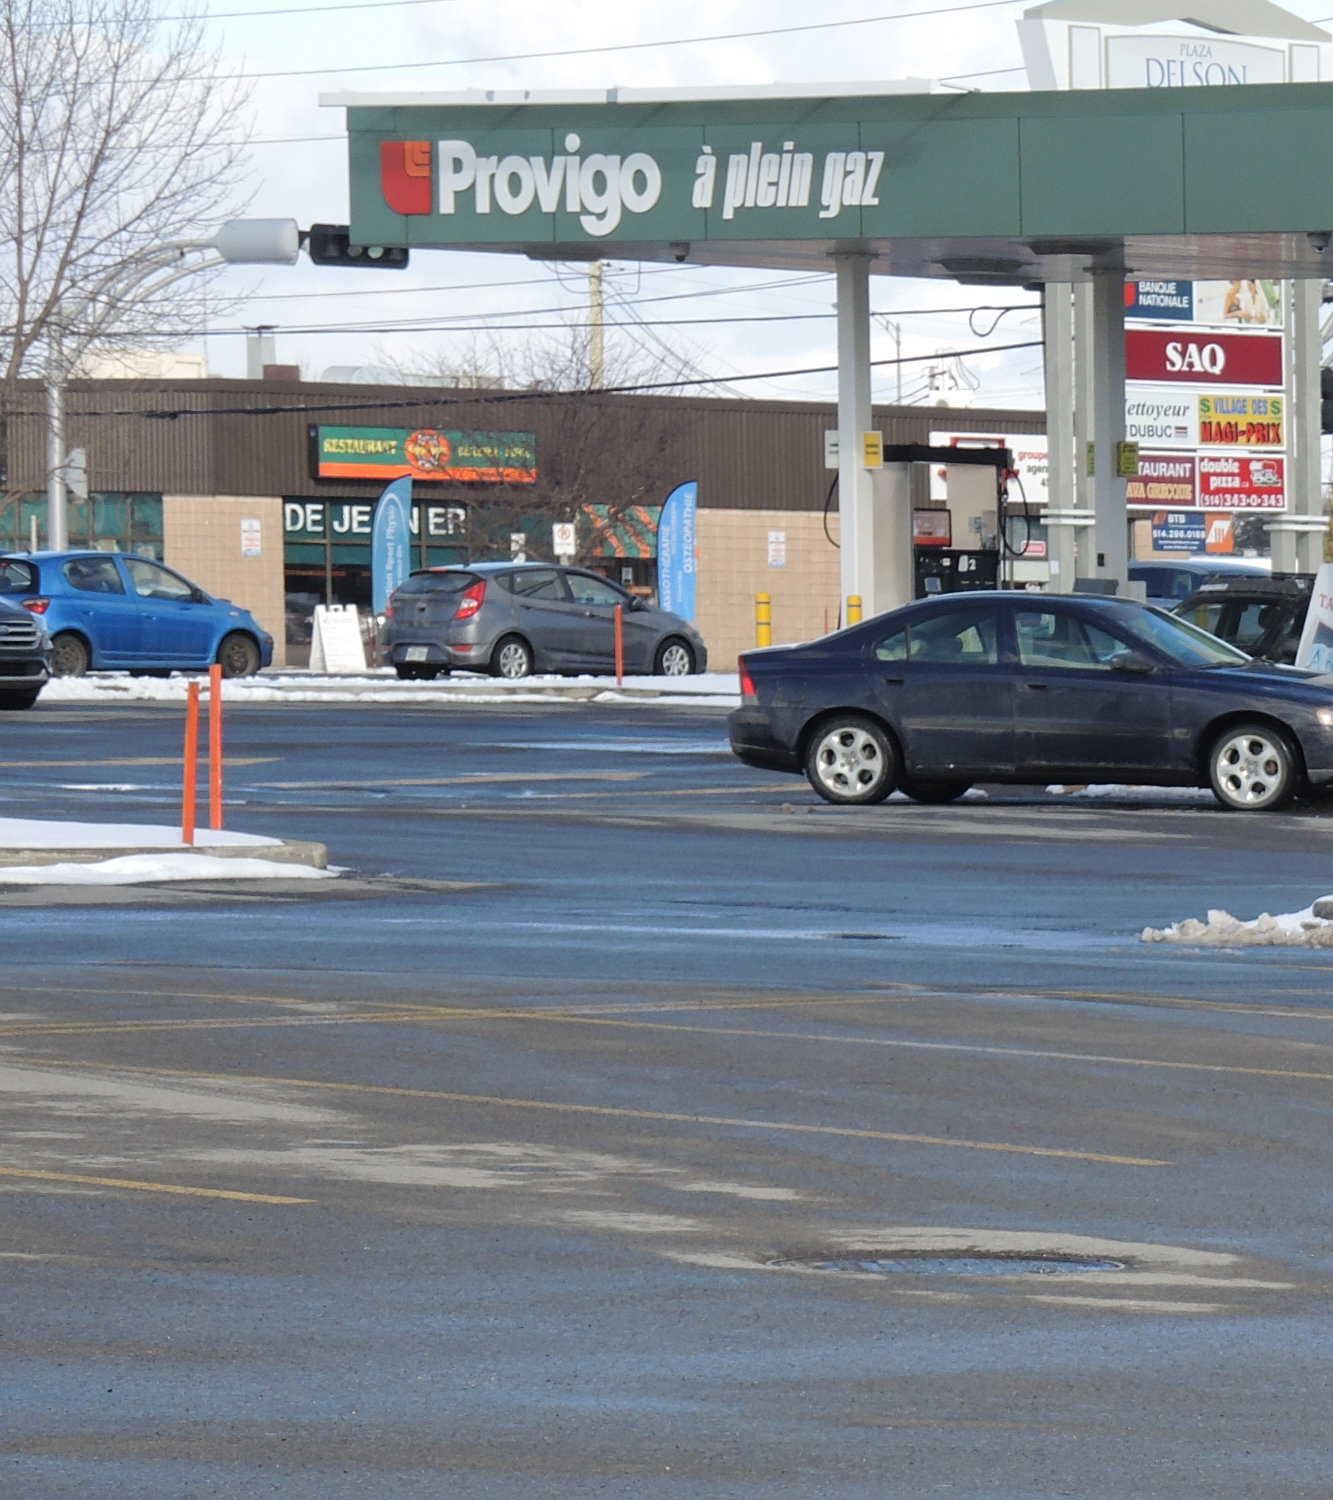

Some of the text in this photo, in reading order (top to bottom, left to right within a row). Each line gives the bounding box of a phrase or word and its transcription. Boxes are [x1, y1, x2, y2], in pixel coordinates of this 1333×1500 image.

[1180, 43, 1213, 58] PLAZA
[438, 133, 662, 236] Provigo
[692, 141, 885, 219] à plein gaz
[1138, 281, 1177, 294] BANQUE
[1138, 295, 1190, 308] NATIONALE
[1165, 341, 1226, 375] SAQ
[1126, 401, 1191, 421] ettoyeur
[1214, 399, 1248, 414] VILLAGE
[1252, 400, 1268, 415] DES
[1129, 424, 1172, 438] DUBUC
[1200, 421, 1281, 444] MAGI-PRIX
[1200, 458, 1240, 473] double
[1210, 475, 1241, 490] pizza
